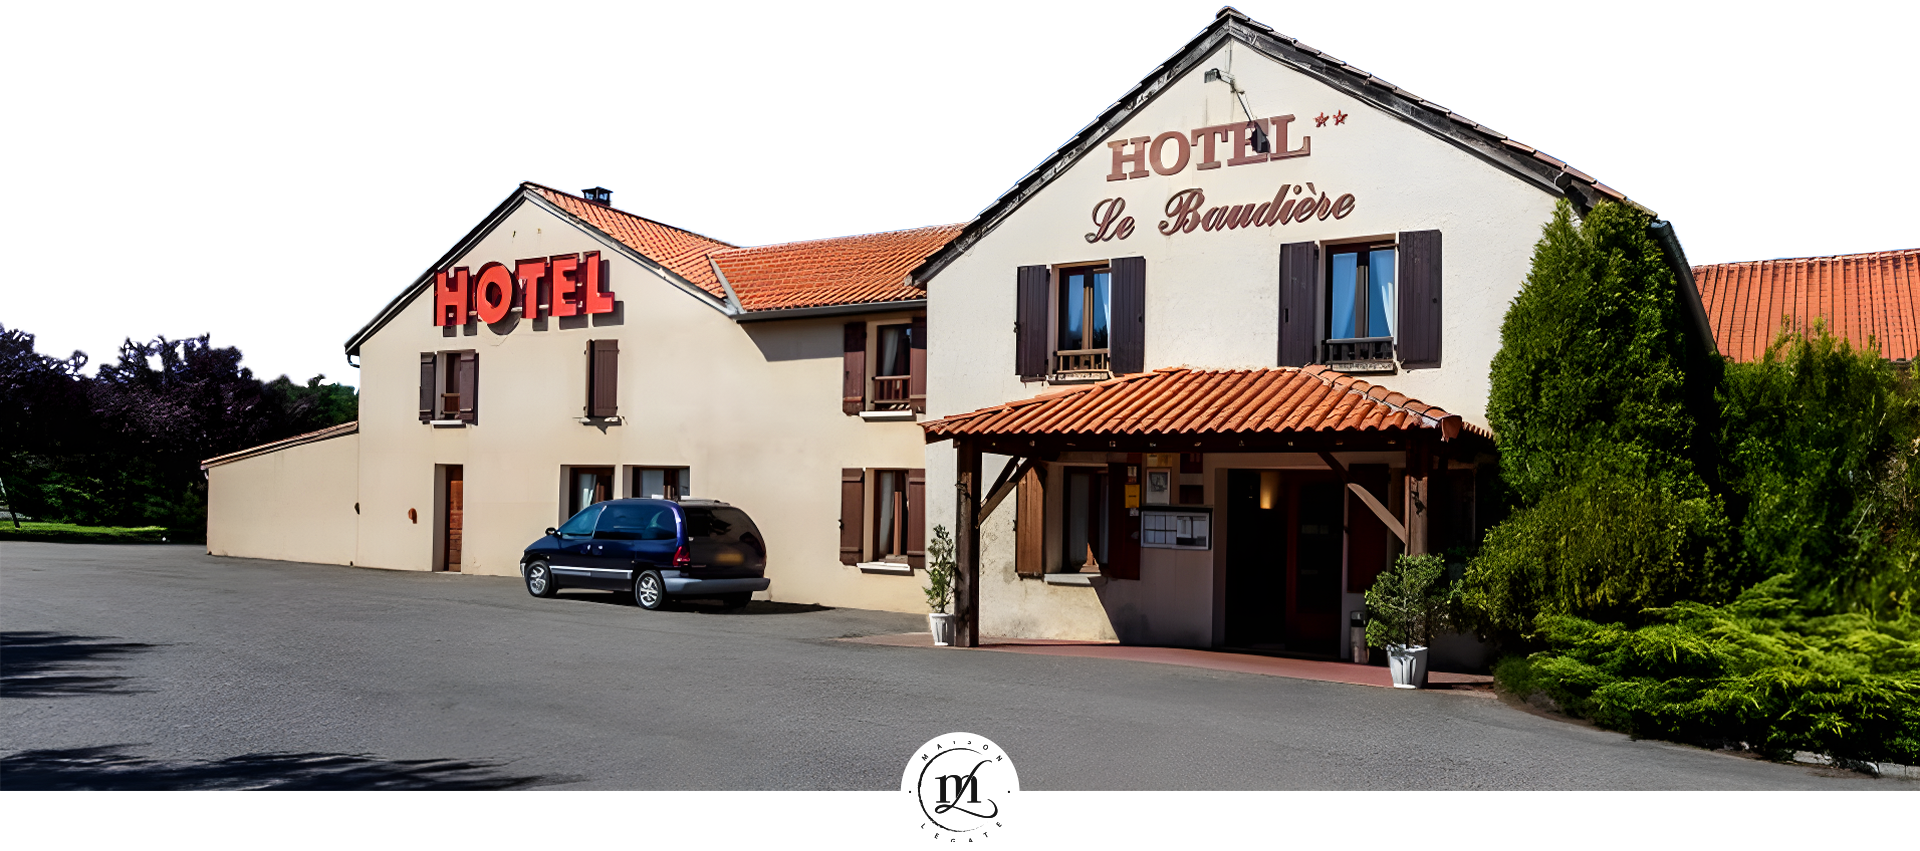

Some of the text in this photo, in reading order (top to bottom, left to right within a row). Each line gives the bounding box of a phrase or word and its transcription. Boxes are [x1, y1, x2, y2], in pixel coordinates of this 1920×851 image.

[1106, 114, 1311, 182] HOTEL
[1084, 182, 1355, 243] Le Baudière
[434, 250, 614, 326] HOTEL
